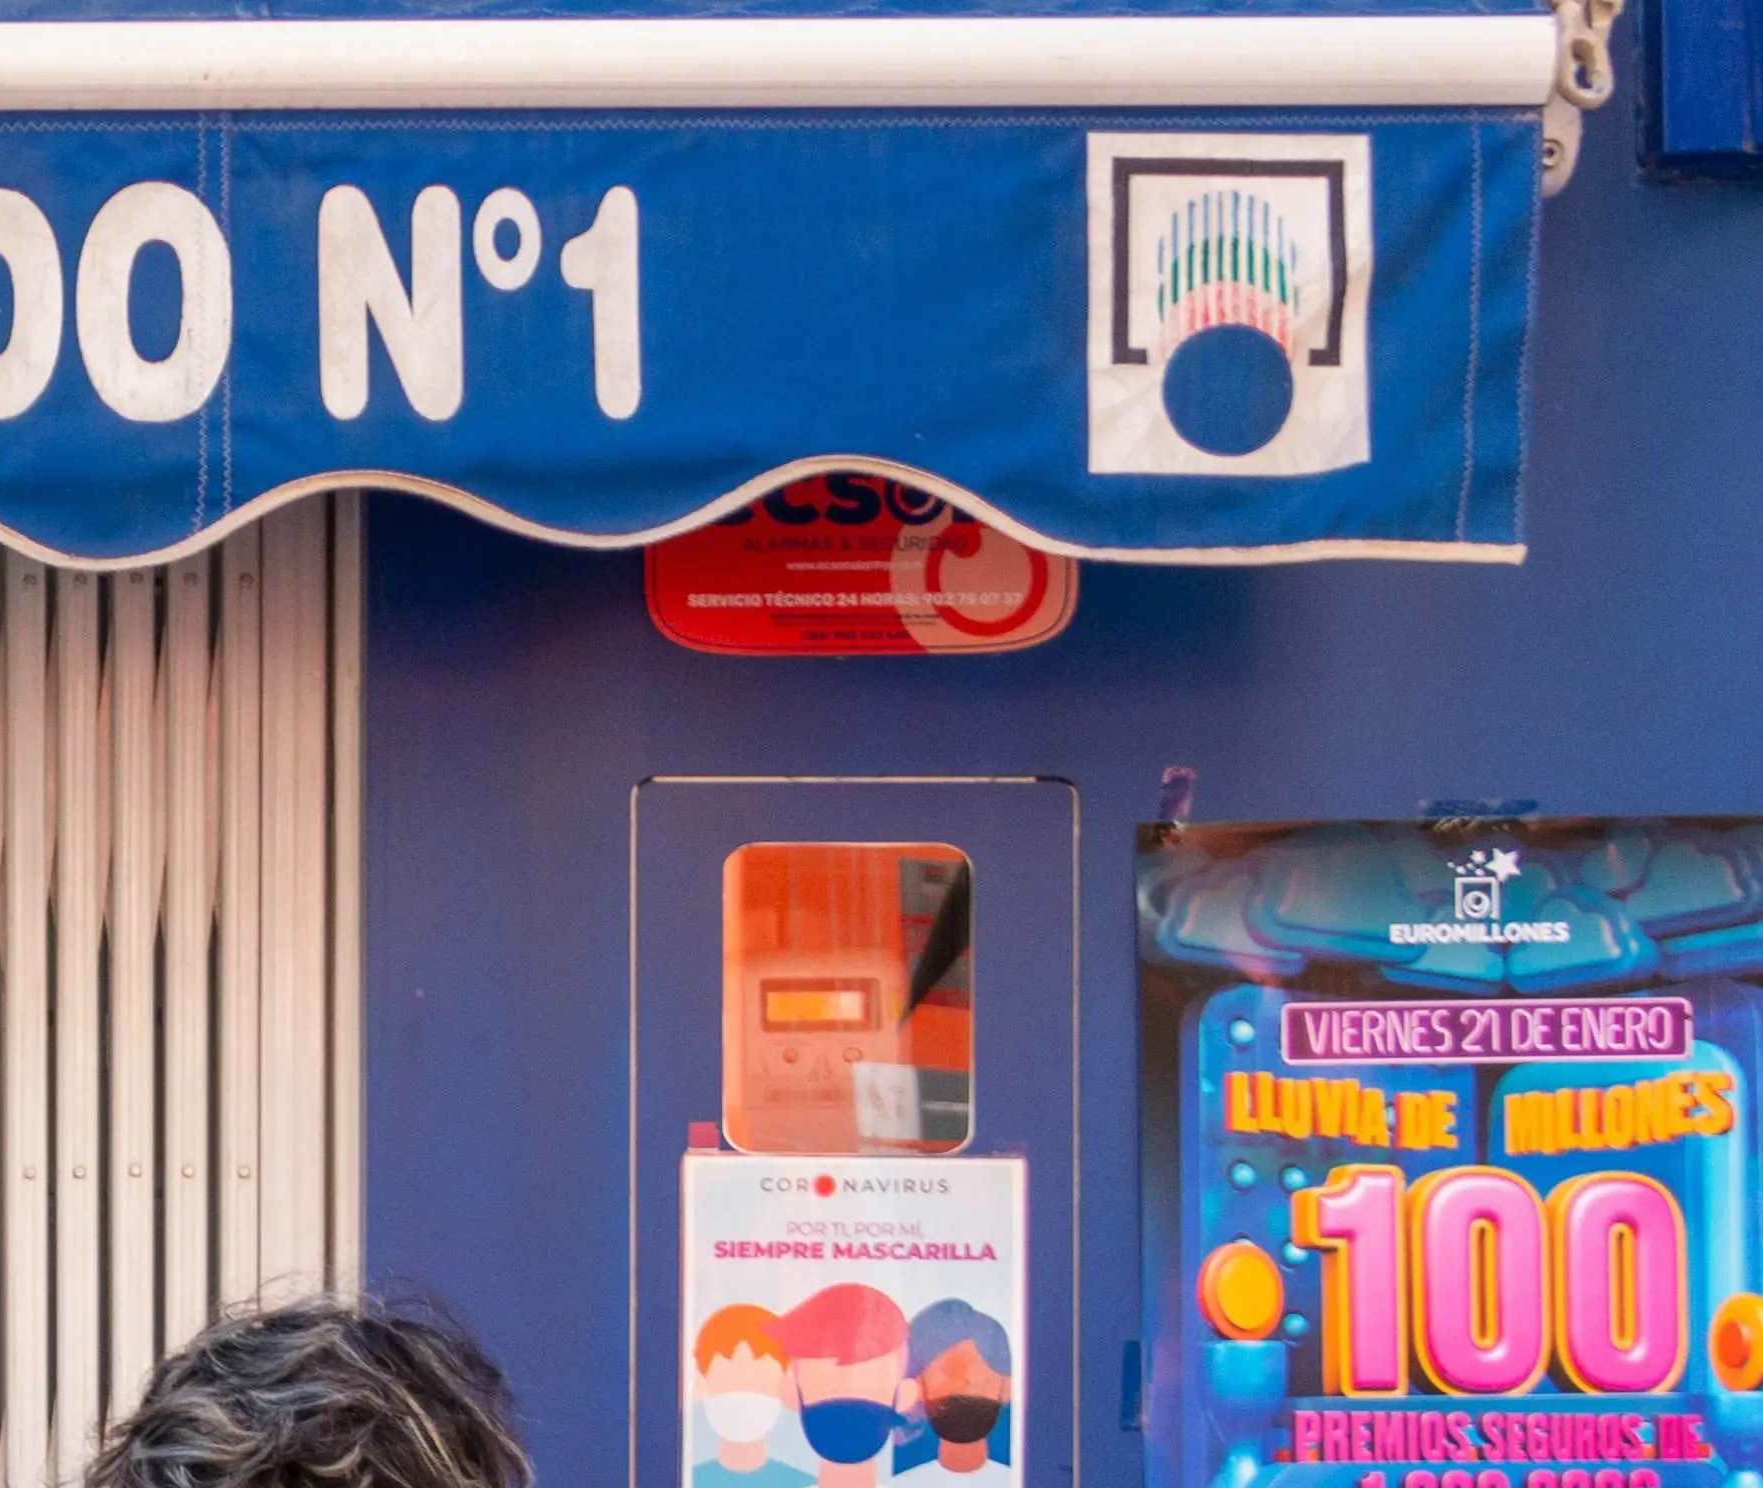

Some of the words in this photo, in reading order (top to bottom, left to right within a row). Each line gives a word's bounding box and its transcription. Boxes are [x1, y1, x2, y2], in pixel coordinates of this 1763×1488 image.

[743, 536, 834, 552] ALARMAS
[856, 535, 968, 552] SEGURIDAD
[687, 592, 763, 608] SERVICIO
[764, 590, 835, 608] TÉCNICO
[836, 592, 859, 607] 24
[1389, 921, 1570, 944] EUROMILLONES
[1303, 1007, 1451, 1054] VIERNES
[1461, 1008, 1502, 1052] 21
[1510, 1006, 1555, 1051] DE
[1561, 1004, 1674, 1050] ENERO
[1224, 1070, 1390, 1148] LLUVIA
[1394, 1088, 1459, 1150] DE
[1503, 1069, 1736, 1156] MILLONES
[786, 1221, 827, 1237] POR
[854, 1221, 896, 1238] POR
[714, 1241, 824, 1260] SIEMPRE
[833, 1241, 997, 1261] MASCARILLA
[1290, 1163, 1688, 1396] 100
[1294, 1410, 1475, 1463] PREMIOS
[1479, 1411, 1644, 1463] SEGUROS
[1655, 1413, 1707, 1460] DE
